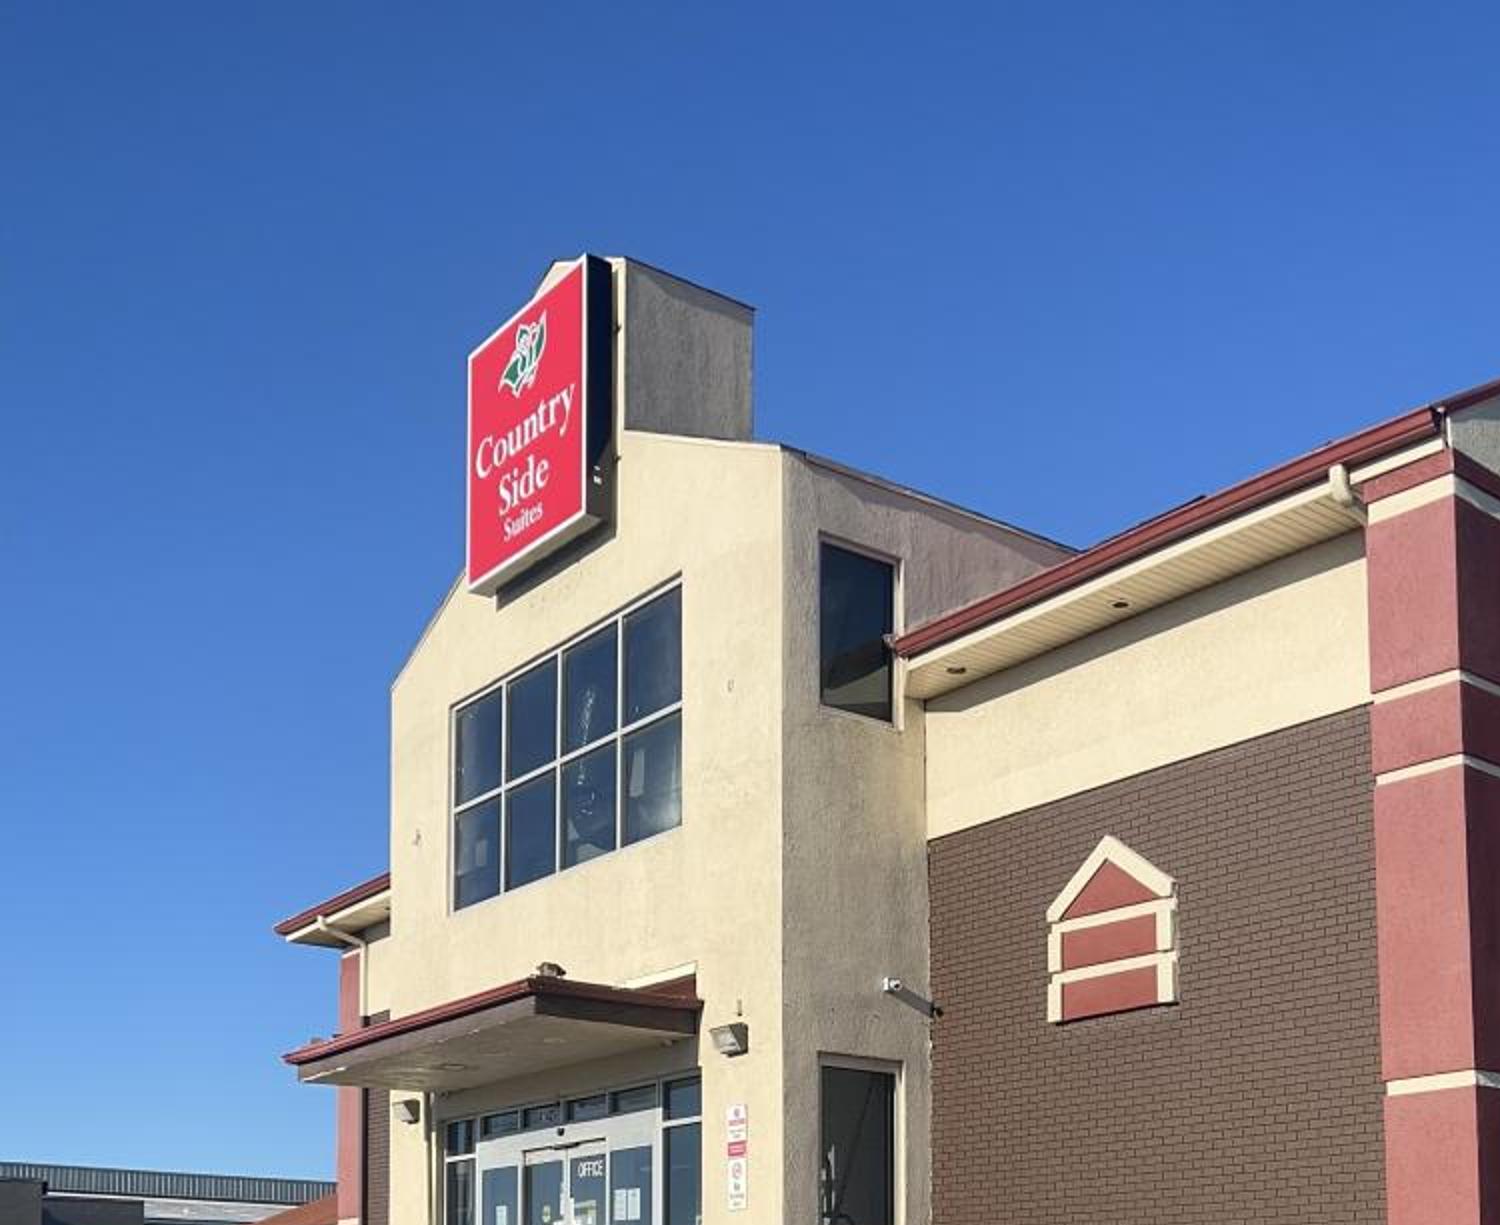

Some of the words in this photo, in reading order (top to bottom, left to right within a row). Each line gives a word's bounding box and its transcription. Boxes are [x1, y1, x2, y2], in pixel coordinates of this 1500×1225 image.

[475, 383, 576, 478] Country
[498, 455, 550, 515] Side
[503, 501, 543, 542] Suites
